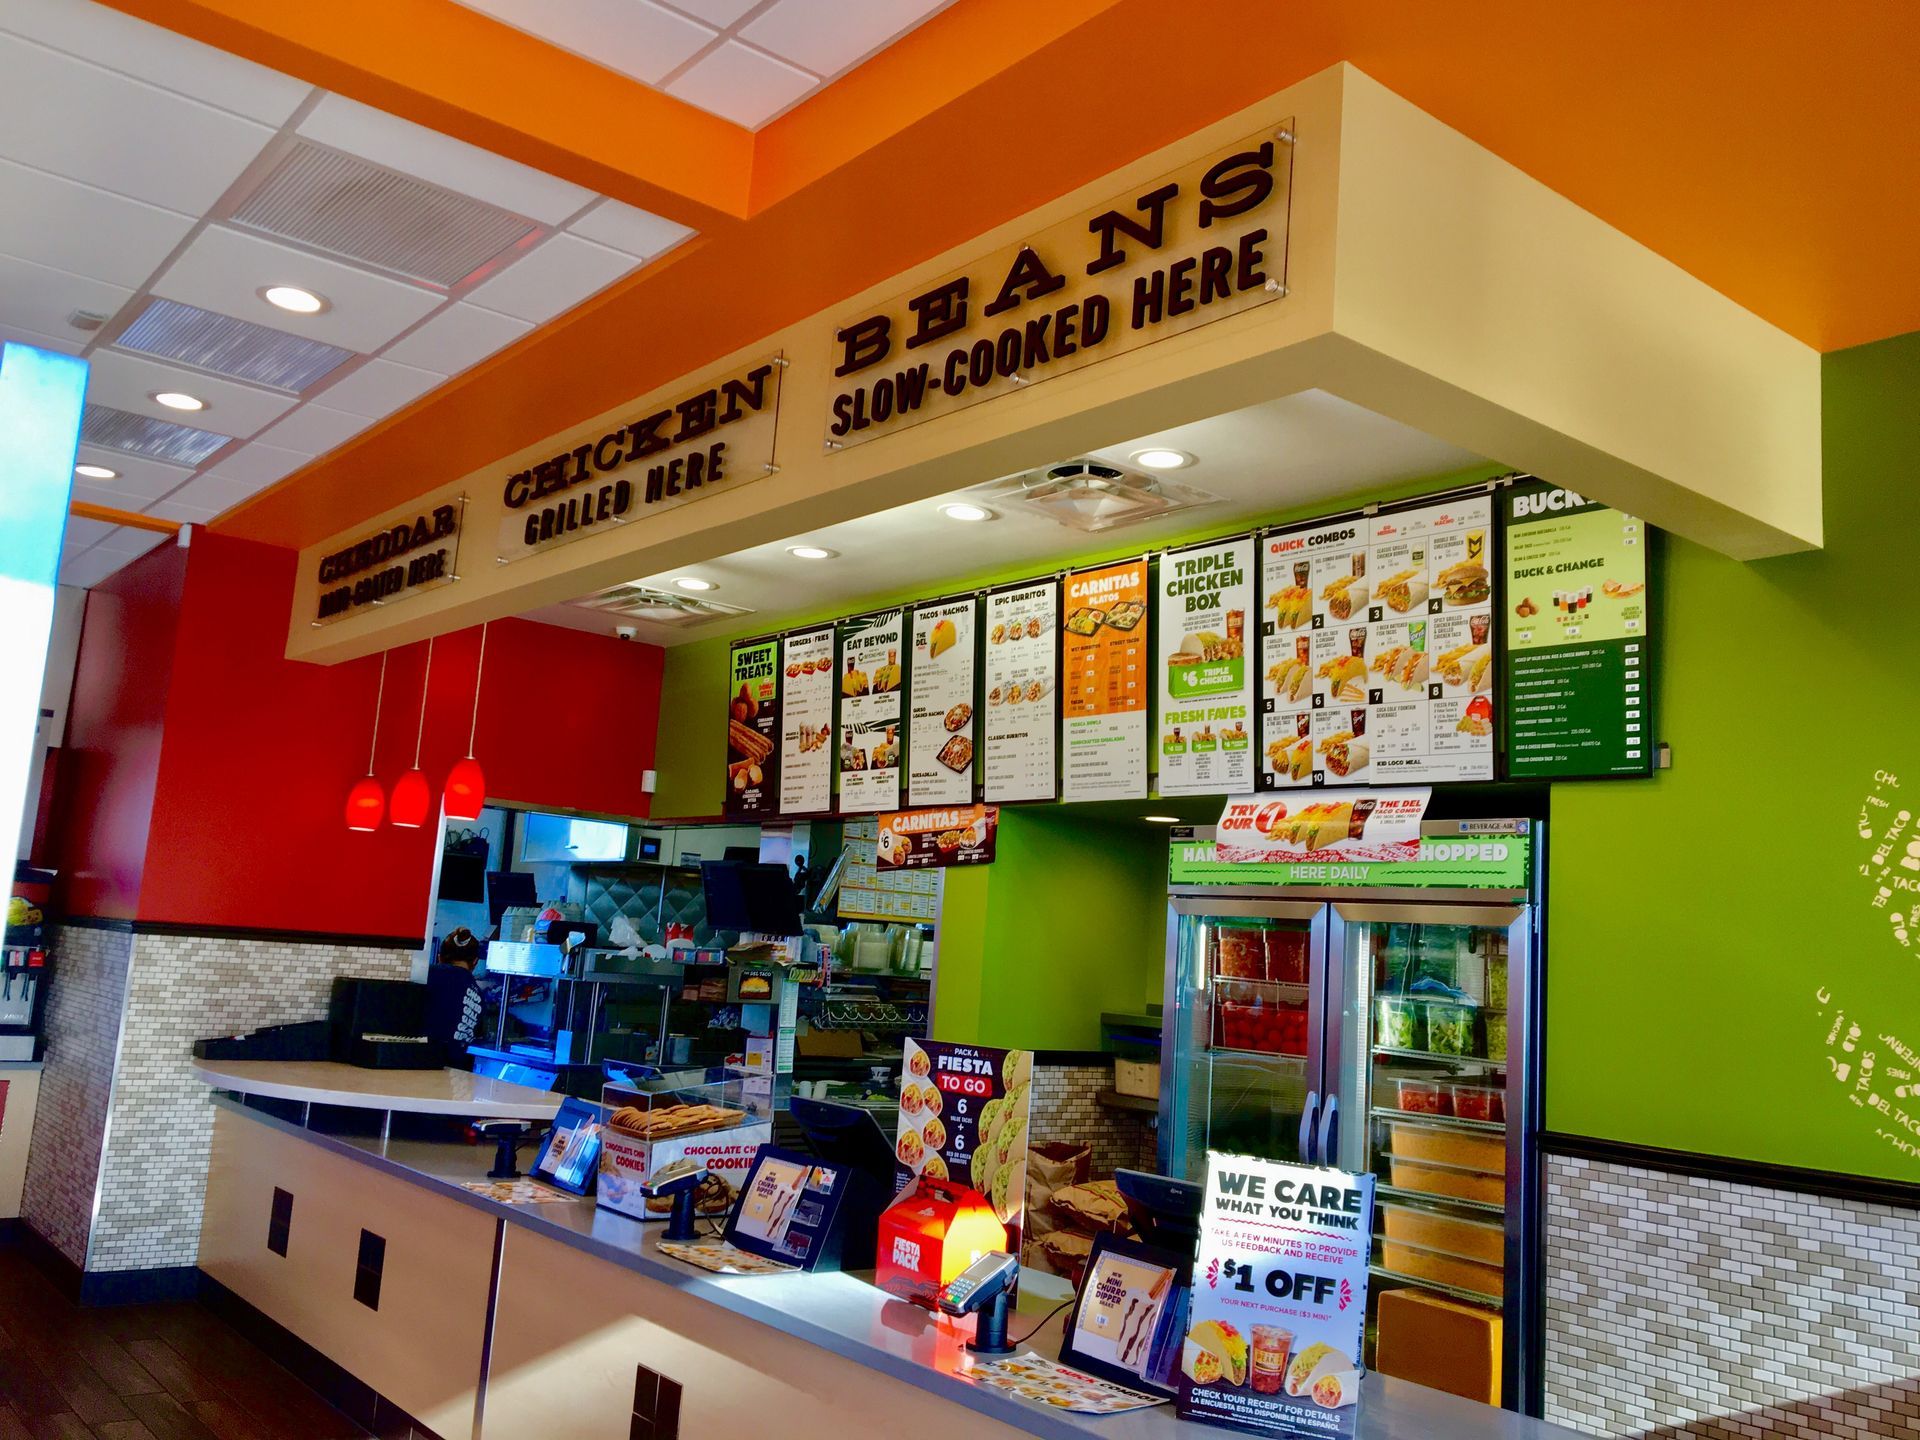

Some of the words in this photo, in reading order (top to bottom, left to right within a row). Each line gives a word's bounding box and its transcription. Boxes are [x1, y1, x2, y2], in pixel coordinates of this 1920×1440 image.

[835, 141, 1274, 378] BEANS
[831, 295, 1110, 436] SLOW-COOKED
[1131, 228, 1268, 330] HERE
[503, 364, 772, 508] CHICKEN
[524, 480, 631, 545] GRILLED
[645, 442, 725, 504] HERE
[1270, 539, 1305, 553] QUICK
[1307, 528, 1356, 546] COMBOS
[1175, 551, 1234, 577] TRIPLE
[1514, 566, 1544, 579] BUCK
[1546, 565, 1554, 574] &
[1555, 558, 1604, 574] CHANGE
[1070, 571, 1140, 598] CARNITAS
[1166, 568, 1243, 597] CHICKEN
[995, 597, 1009, 606] EPIC
[1011, 589, 1046, 603] BURRITOS
[1088, 592, 1120, 605] PLATOS
[1185, 591, 1221, 612] BOX
[1432, 602, 1438, 610] 4
[920, 611, 938, 620] TACOS
[943, 605, 968, 616] NACHOS
[1315, 617, 1321, 626] 2
[1374, 609, 1380, 619] 3
[1266, 624, 1271, 633] 1
[789, 637, 812, 647] BURGERS
[814, 634, 829, 642] FRIES
[847, 639, 863, 651] EAT
[864, 632, 898, 647] BEYOND
[738, 648, 771, 666] SWEET
[735, 663, 773, 681] TREATS
[1183, 670, 1198, 687] $6
[1203, 667, 1230, 677] TRIPLE
[1199, 675, 1233, 686] CHICKEN
[1315, 696, 1321, 705] 6
[1375, 691, 1380, 701] 7
[1433, 687, 1439, 696] 8
[1165, 709, 1205, 724] FRESH
[1207, 705, 1247, 721] FAVES
[1266, 701, 1272, 710] 5
[1266, 776, 1272, 784] 9
[1313, 773, 1323, 782] 10
[1230, 803, 1260, 816] TRY
[1401, 800, 1422, 808] DEL
[892, 810, 959, 833] CARNITAS
[1222, 818, 1254, 831] OUR
[1872, 843, 1893, 866] DEL
[1290, 866, 1326, 879] HERE
[1330, 865, 1370, 879] DAILY
[954, 1048, 973, 1056] PACK
[938, 1055, 993, 1076] FIESTA
[1856, 1051, 1875, 1091] TACOS
[942, 1075, 960, 1090] TO
[964, 1078, 985, 1094] GO
[957, 1098, 967, 1114] 6
[1868, 1093, 1890, 1116] DEL
[605, 1142, 633, 1156] CHOCOLATE
[633, 1149, 645, 1158] CHIP
[684, 1145, 741, 1155] CHOCOLATE
[955, 1134, 965, 1150] 6
[616, 1155, 645, 1172] COOKIES
[757, 1187, 774, 1196] DIPPER
[758, 1180, 777, 1190] CHURRO
[1218, 1170, 1266, 1199] WE
[1274, 1179, 1363, 1214] CARE
[1216, 1197, 1263, 1215] WHAT
[1269, 1205, 1303, 1222] YOU
[1307, 1211, 1359, 1230] THINK
[894, 1236, 920, 1257] FIESTA
[1210, 1227, 1230, 1237] TAKE
[1242, 1232, 1261, 1241] FEW
[1263, 1235, 1303, 1249] MINUTES
[1305, 1241, 1317, 1251] TO
[1318, 1244, 1358, 1258] PROVIDE
[892, 1249, 920, 1273] PACK
[1222, 1239, 1233, 1247] US
[1235, 1241, 1282, 1255] FEEDBACK
[1283, 1249, 1303, 1258] AND
[1305, 1252, 1344, 1265] RECEIVE
[1096, 1282, 1127, 1297] CHURRO
[1106, 1276, 1122, 1288] MINI
[1222, 1257, 1255, 1293] $1
[1265, 1269, 1337, 1305] OFF
[1095, 1290, 1122, 1306] DIPPER
[1220, 1297, 1239, 1306] YOUR
[1240, 1300, 1259, 1310] NEXT
[1260, 1303, 1298, 1316] PURCHASE
[1055, 1368, 1098, 1384] QUICK
[1099, 1383, 1160, 1402] COMBOS
[1190, 1396, 1199, 1404] LA
[1200, 1399, 1235, 1411] ENCUESTA
[1236, 1405, 1254, 1414] ESTA
[1254, 1410, 1296, 1423] DISPONIBLE
[1296, 1416, 1307, 1424] EN
[1307, 1417, 1340, 1431] ESPAÑOL
[1191, 1387, 1221, 1400] CHECK
[1222, 1391, 1246, 1404] YOUR
[1247, 1396, 1284, 1411] RECEIPT
[1285, 1405, 1303, 1416] FOR
[1305, 1409, 1341, 1423] DETAILS
